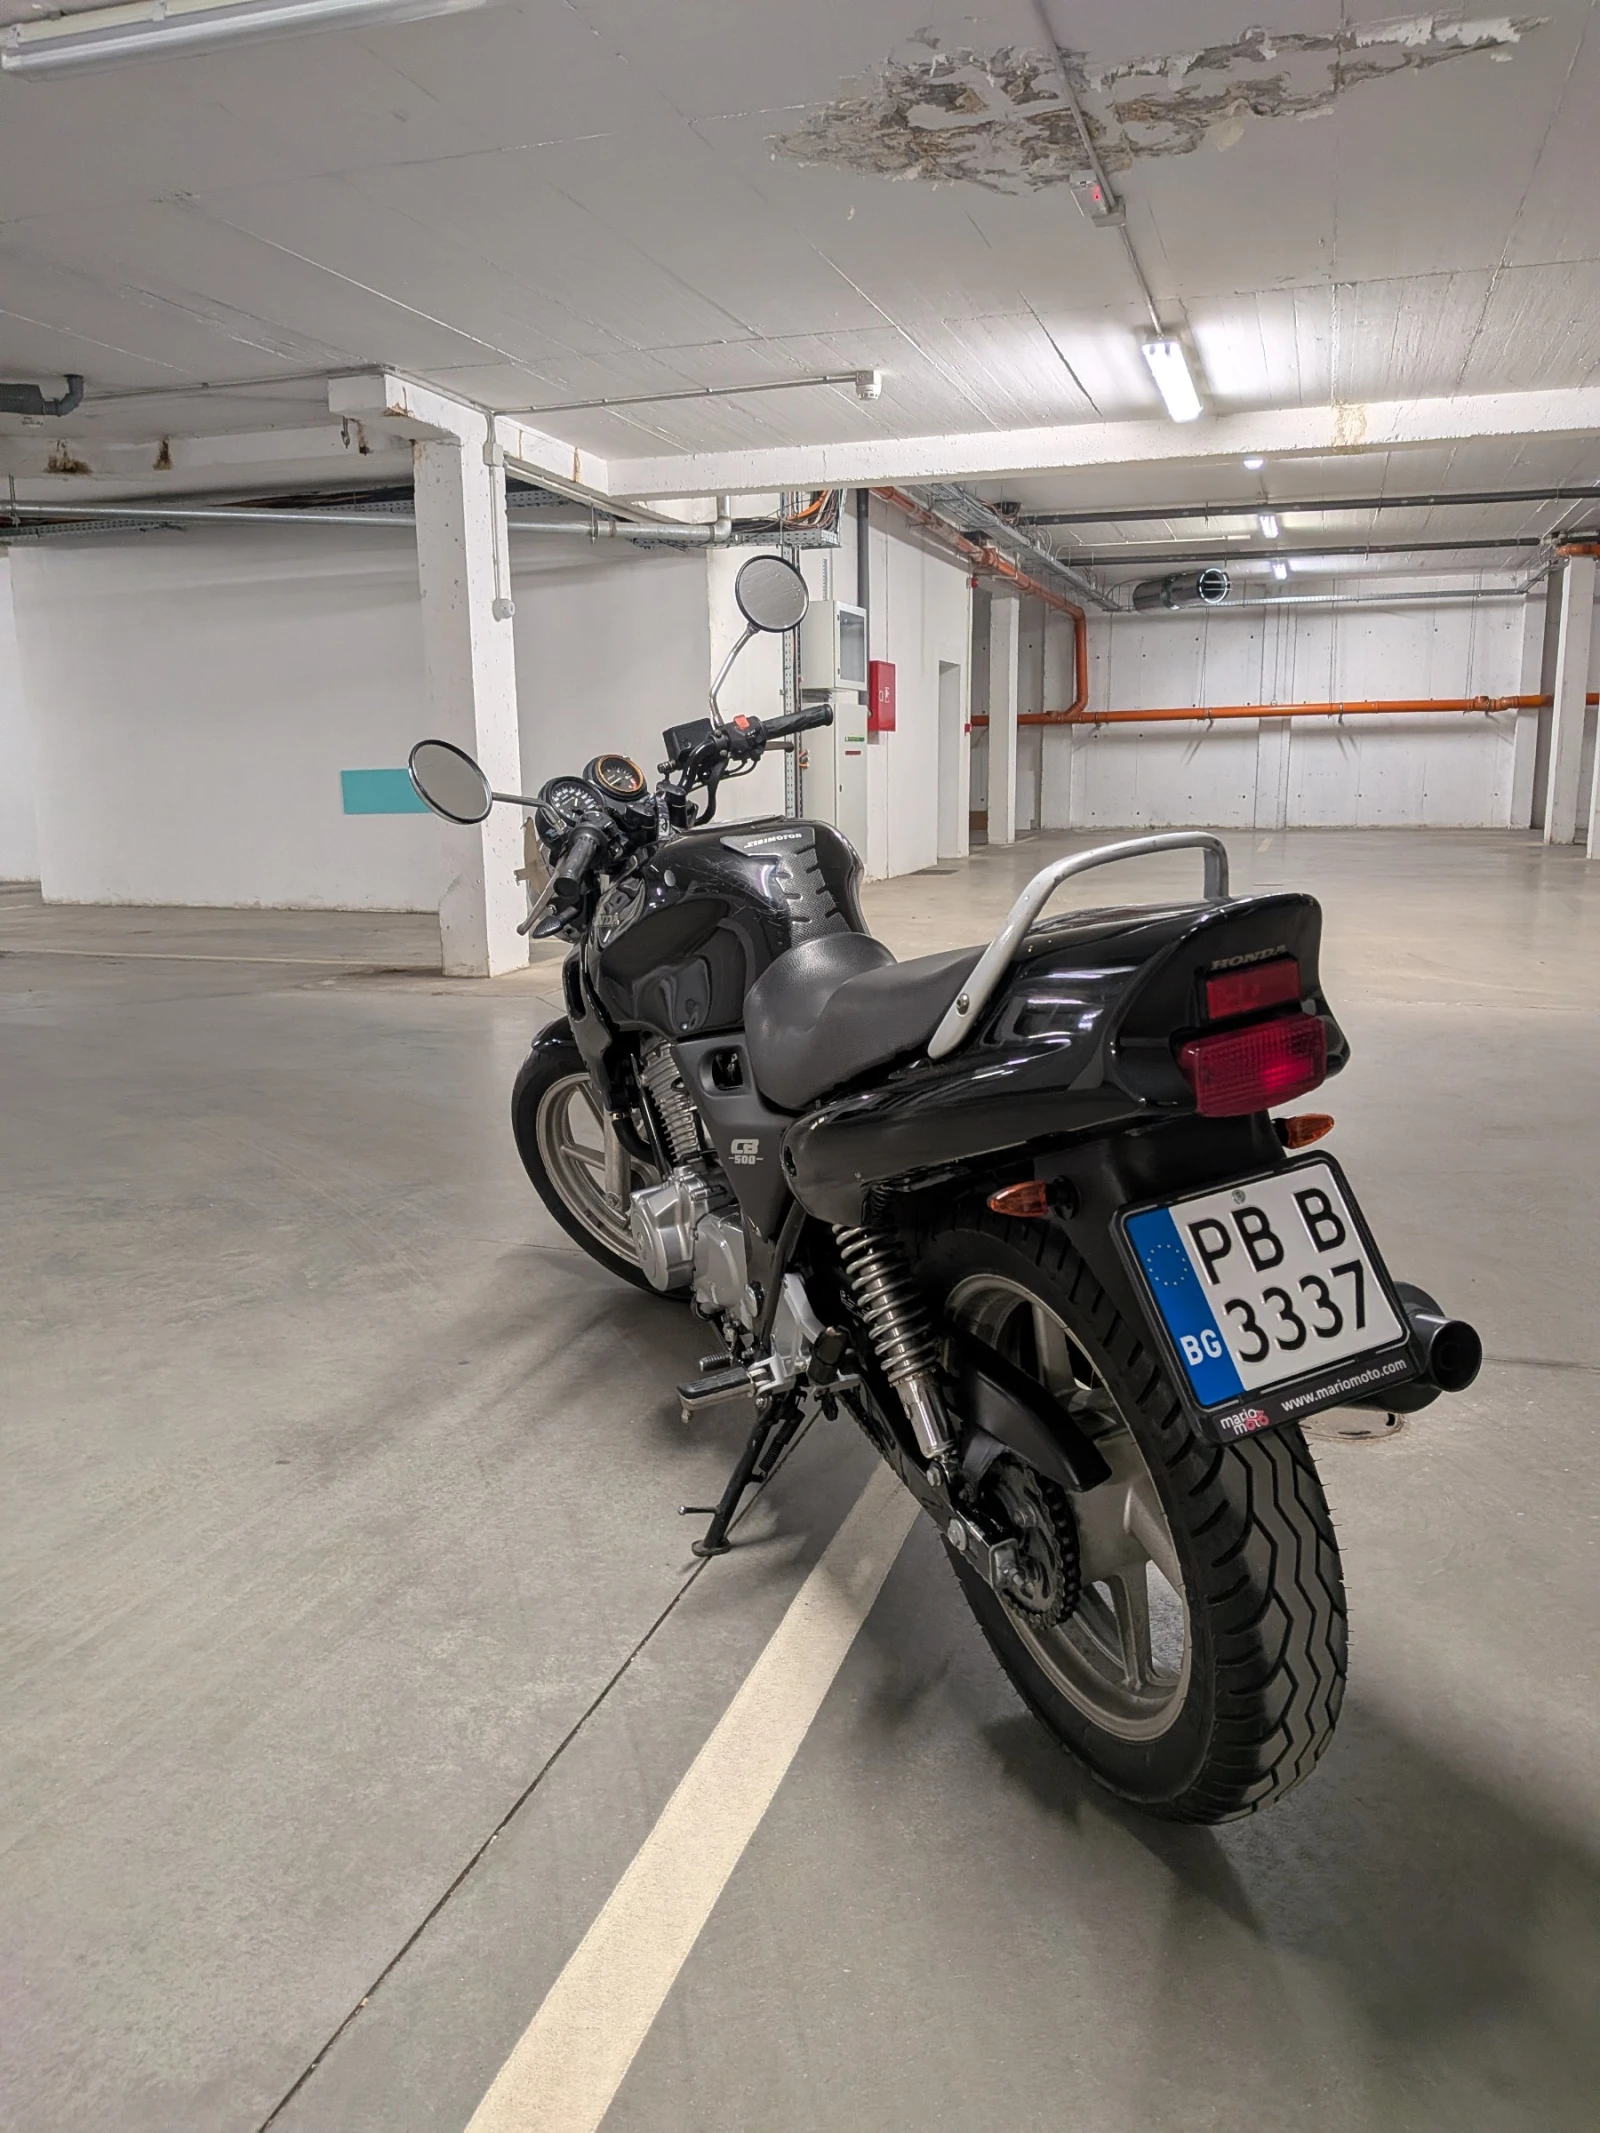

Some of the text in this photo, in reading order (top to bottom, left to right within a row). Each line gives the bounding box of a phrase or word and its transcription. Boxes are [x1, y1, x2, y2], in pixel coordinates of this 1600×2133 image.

[1210, 944, 1289, 971] HONDA
[731, 1138, 760, 1155] CB
[1186, 1187, 1347, 1285] PB B
[1223, 1259, 1367, 1363] 3337
[1180, 1328, 1223, 1367] BG
[1281, 1358, 1407, 1412] www.mariomoto.com
[1220, 1408, 1257, 1429] mario
[1233, 1415, 1269, 1435] moto
